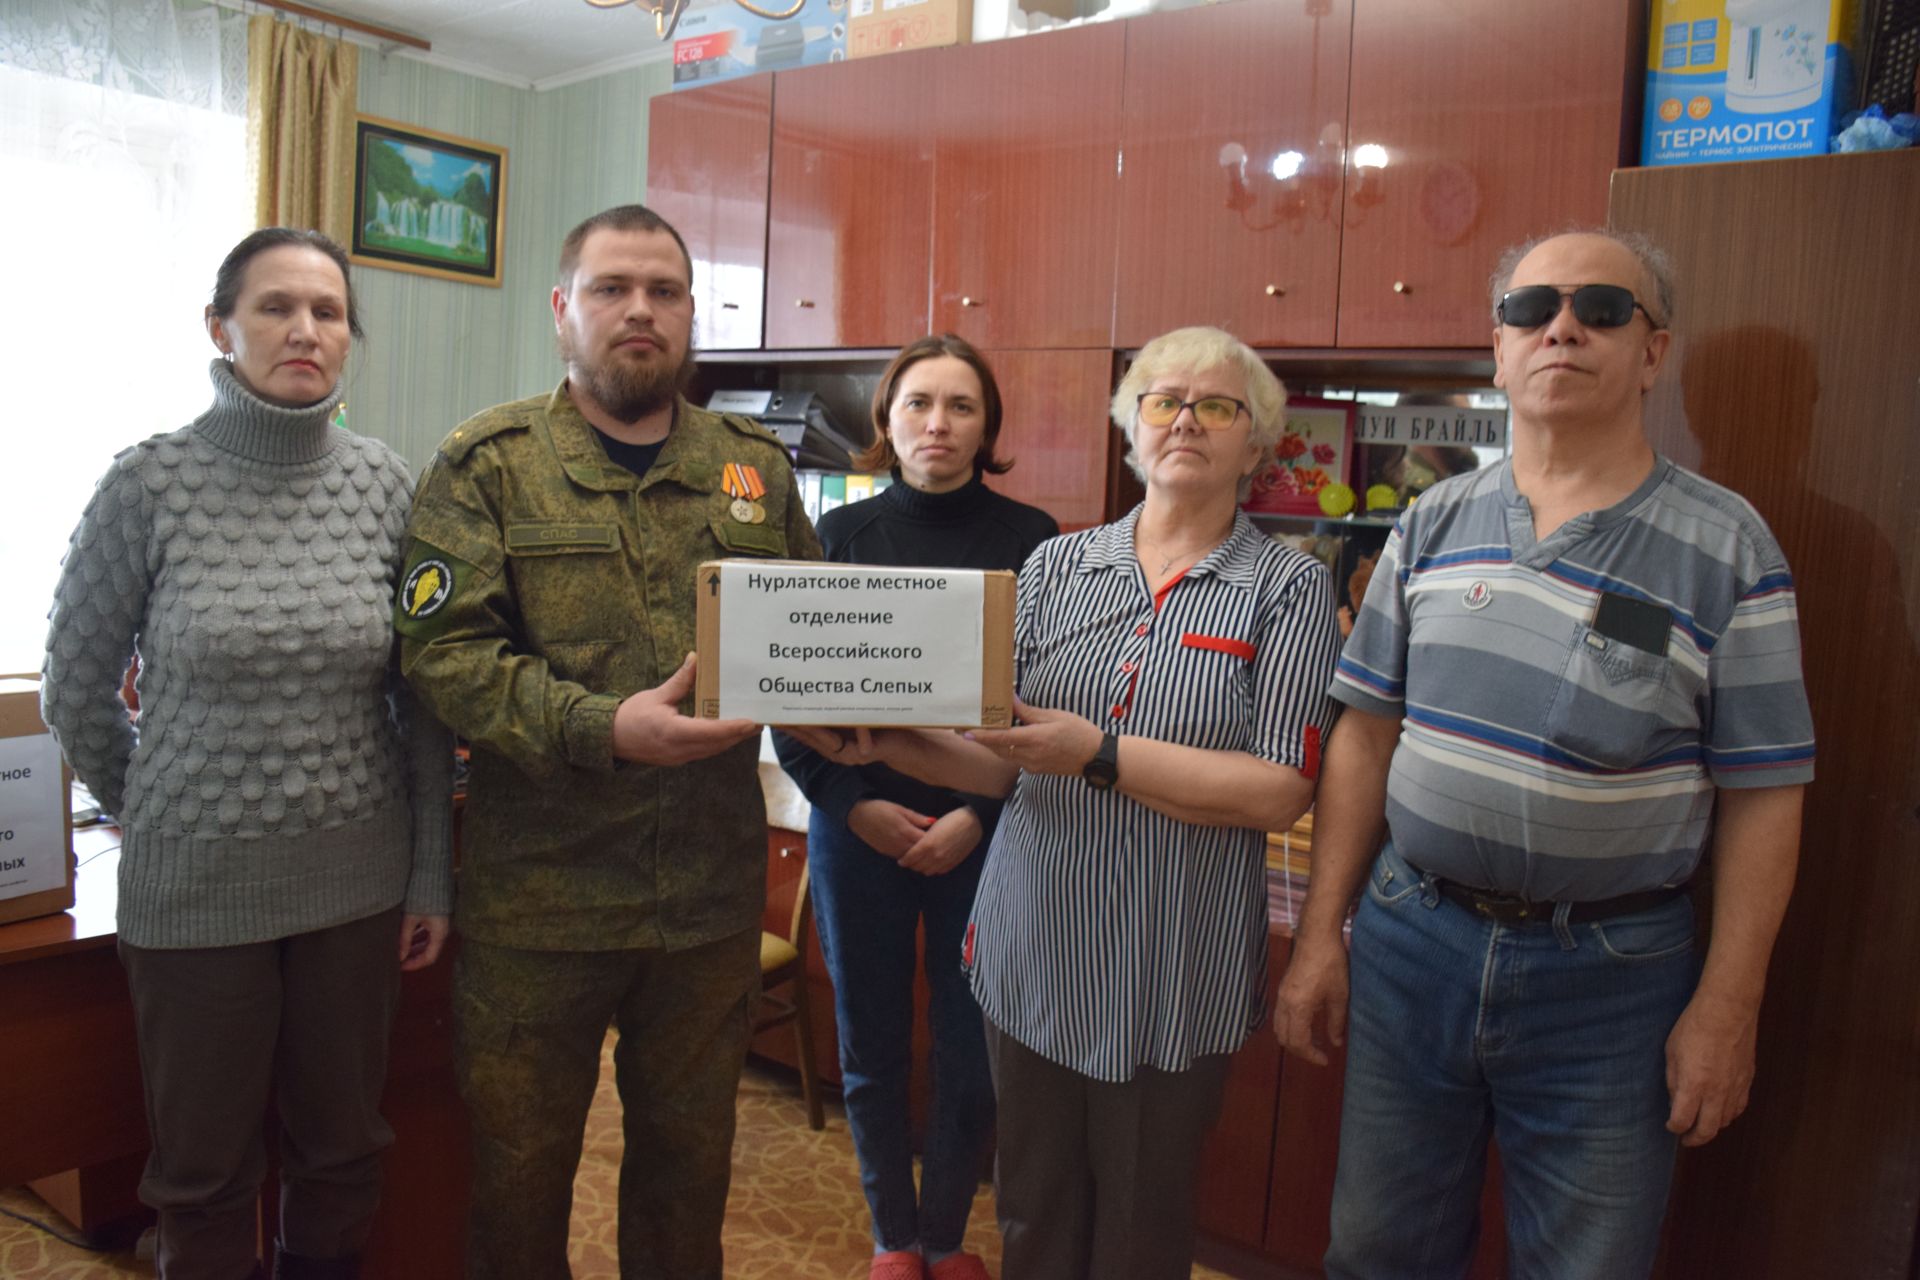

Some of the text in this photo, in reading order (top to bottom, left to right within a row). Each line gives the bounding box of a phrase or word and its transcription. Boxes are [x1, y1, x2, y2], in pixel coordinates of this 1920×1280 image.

[1656, 118, 1814, 149] ТЕРМОПОТ
[1411, 413, 1497, 443] БРАЙЛЬ
[748, 573, 947, 592] Нурлатское местное
[789, 610, 893, 627] отделение
[769, 643, 922, 661] Всероссийского
[758, 677, 933, 697] Общества Слепых
[0, 767, 31, 780] ное
